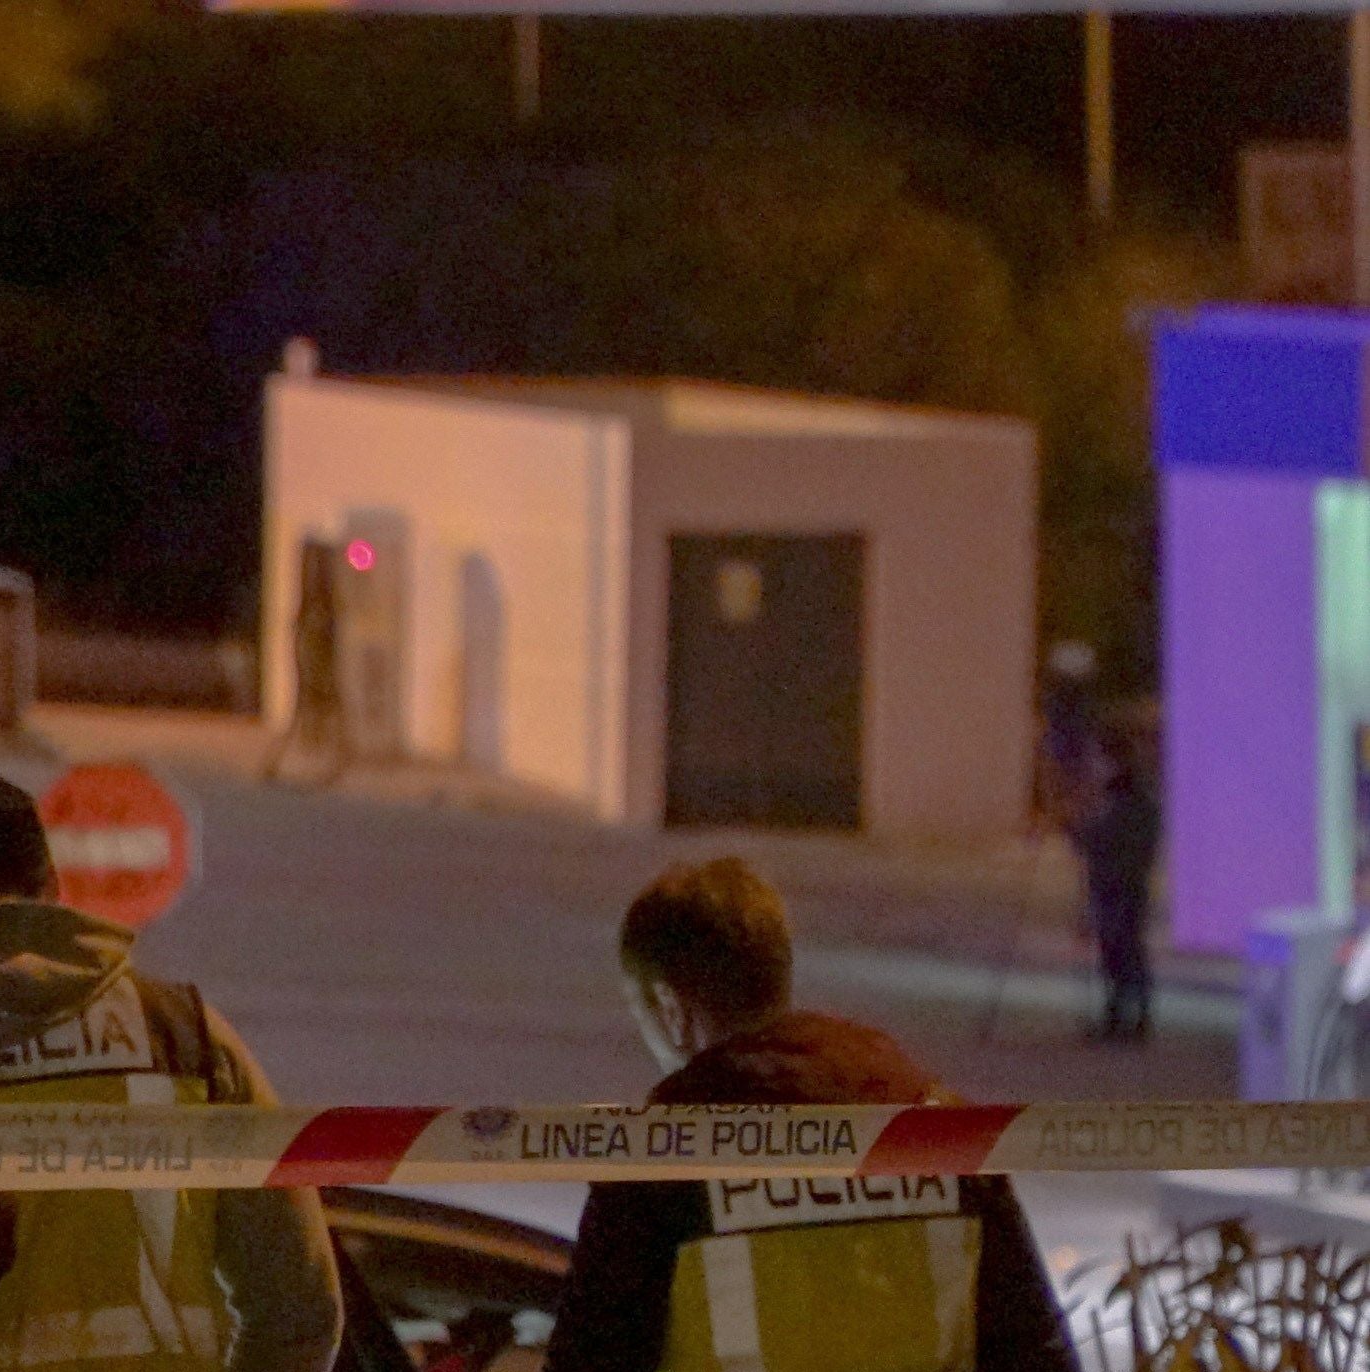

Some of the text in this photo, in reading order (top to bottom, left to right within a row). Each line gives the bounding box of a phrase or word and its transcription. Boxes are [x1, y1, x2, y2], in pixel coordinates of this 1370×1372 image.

[520, 1119, 858, 1159] LINEA DE POLICIA
